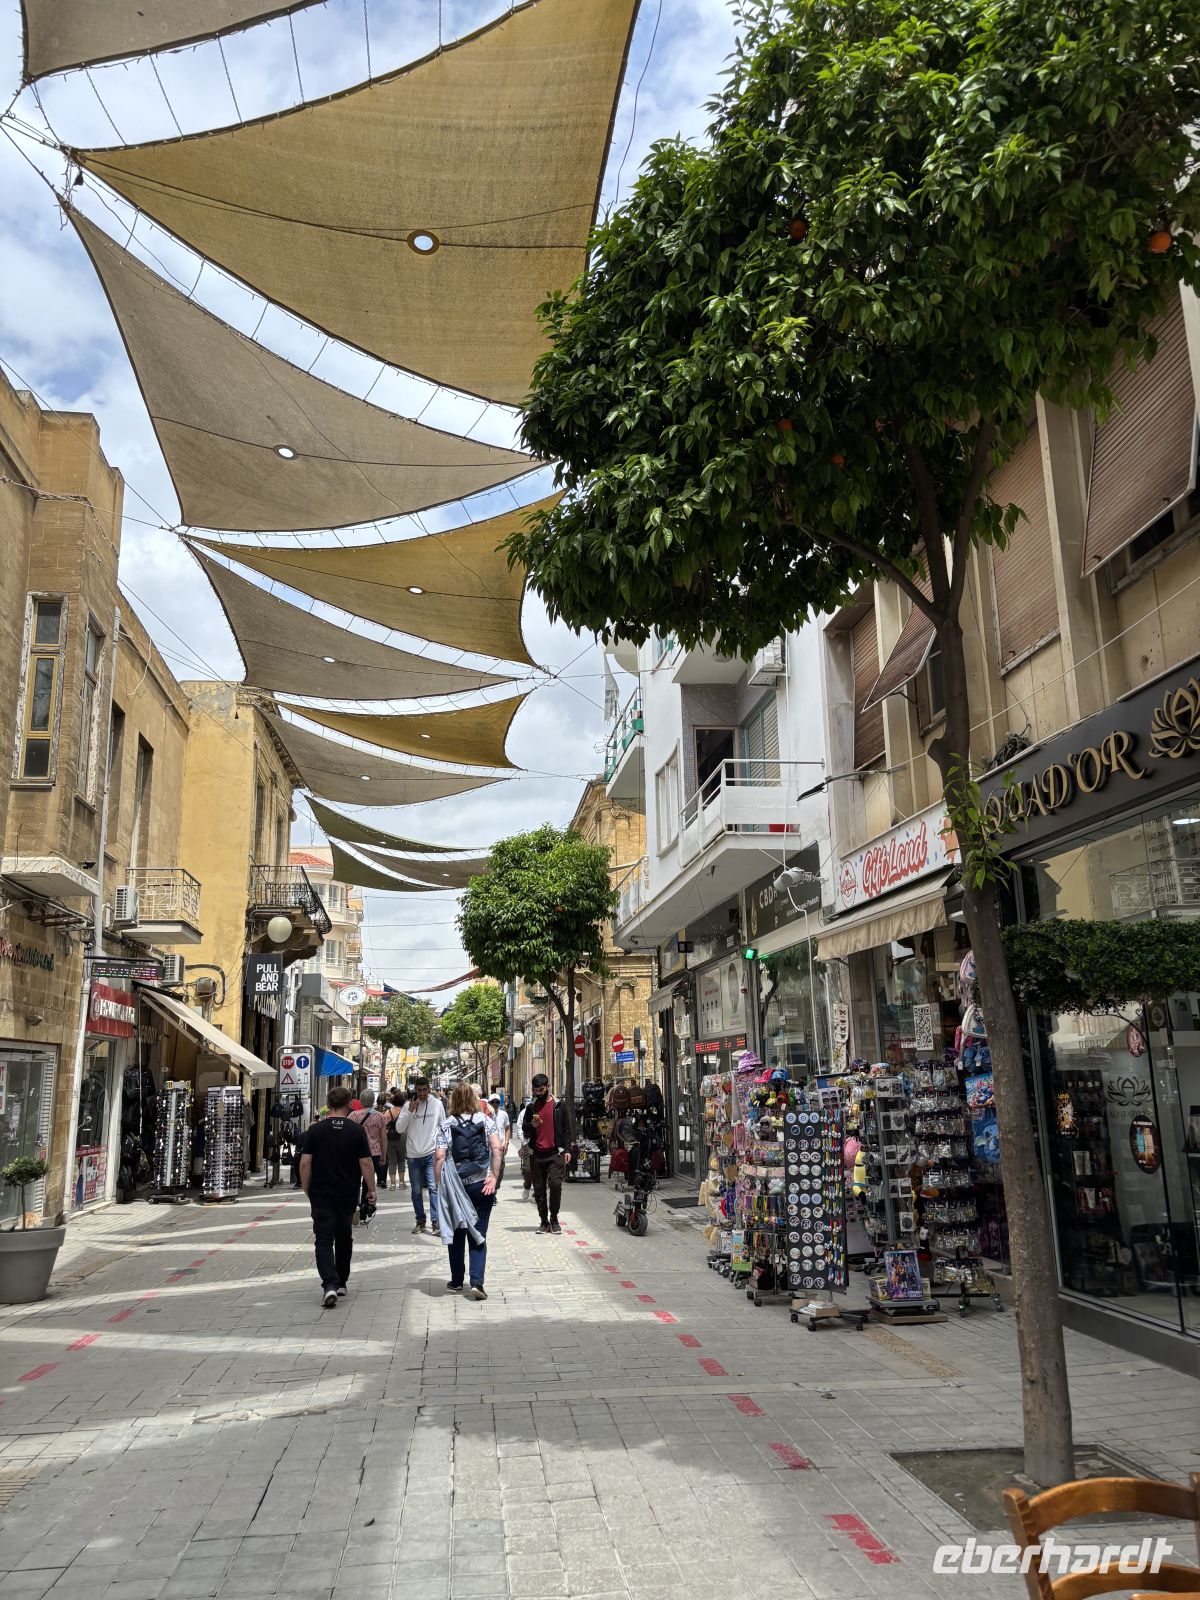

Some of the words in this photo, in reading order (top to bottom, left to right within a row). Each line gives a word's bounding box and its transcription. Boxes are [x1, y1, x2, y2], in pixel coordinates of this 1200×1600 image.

[256, 963, 279, 973] PULL
[261, 972, 279, 982] AND
[255, 982, 279, 992] BEAR
